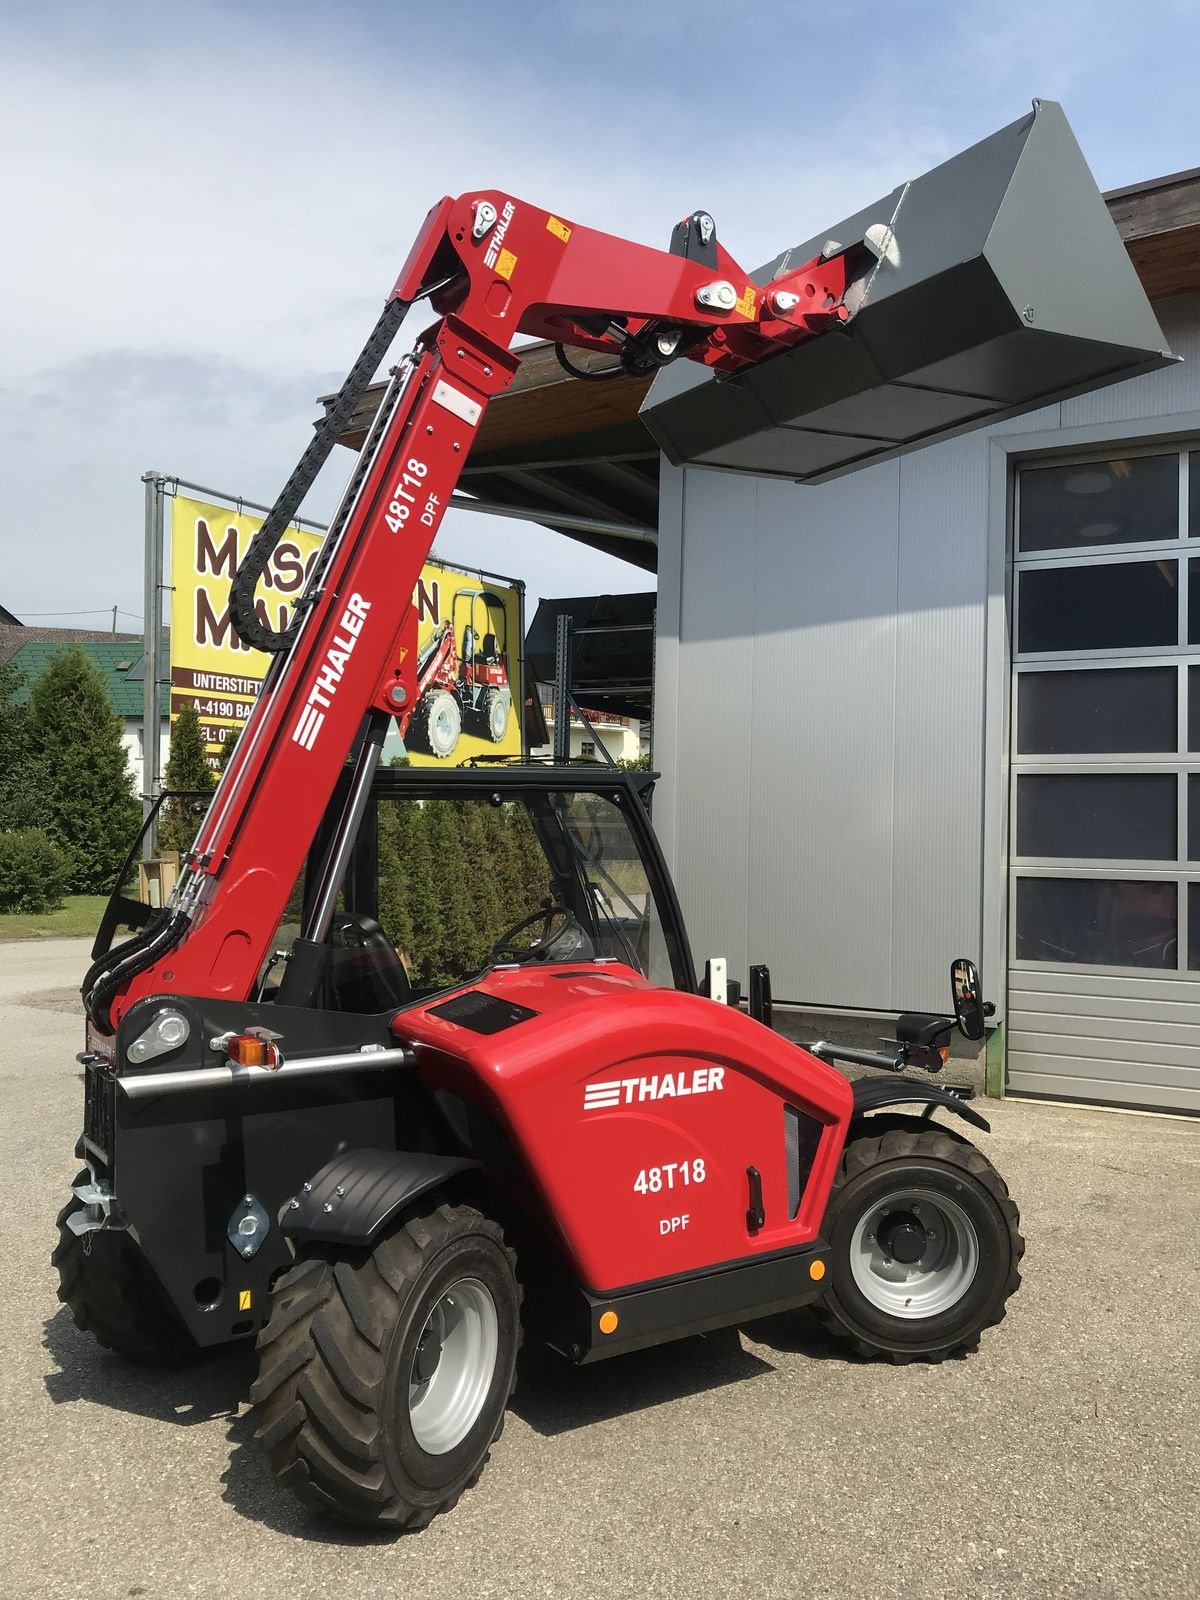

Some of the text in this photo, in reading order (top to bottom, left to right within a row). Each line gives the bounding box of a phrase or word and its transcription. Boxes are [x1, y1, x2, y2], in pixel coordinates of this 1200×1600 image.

[384, 458, 428, 534] 48T18
[420, 492, 440, 527] DPF
[193, 698, 254, 719] A-4190 BA
[633, 1158, 706, 1195] 48T18
[659, 1214, 690, 1235] DPF
